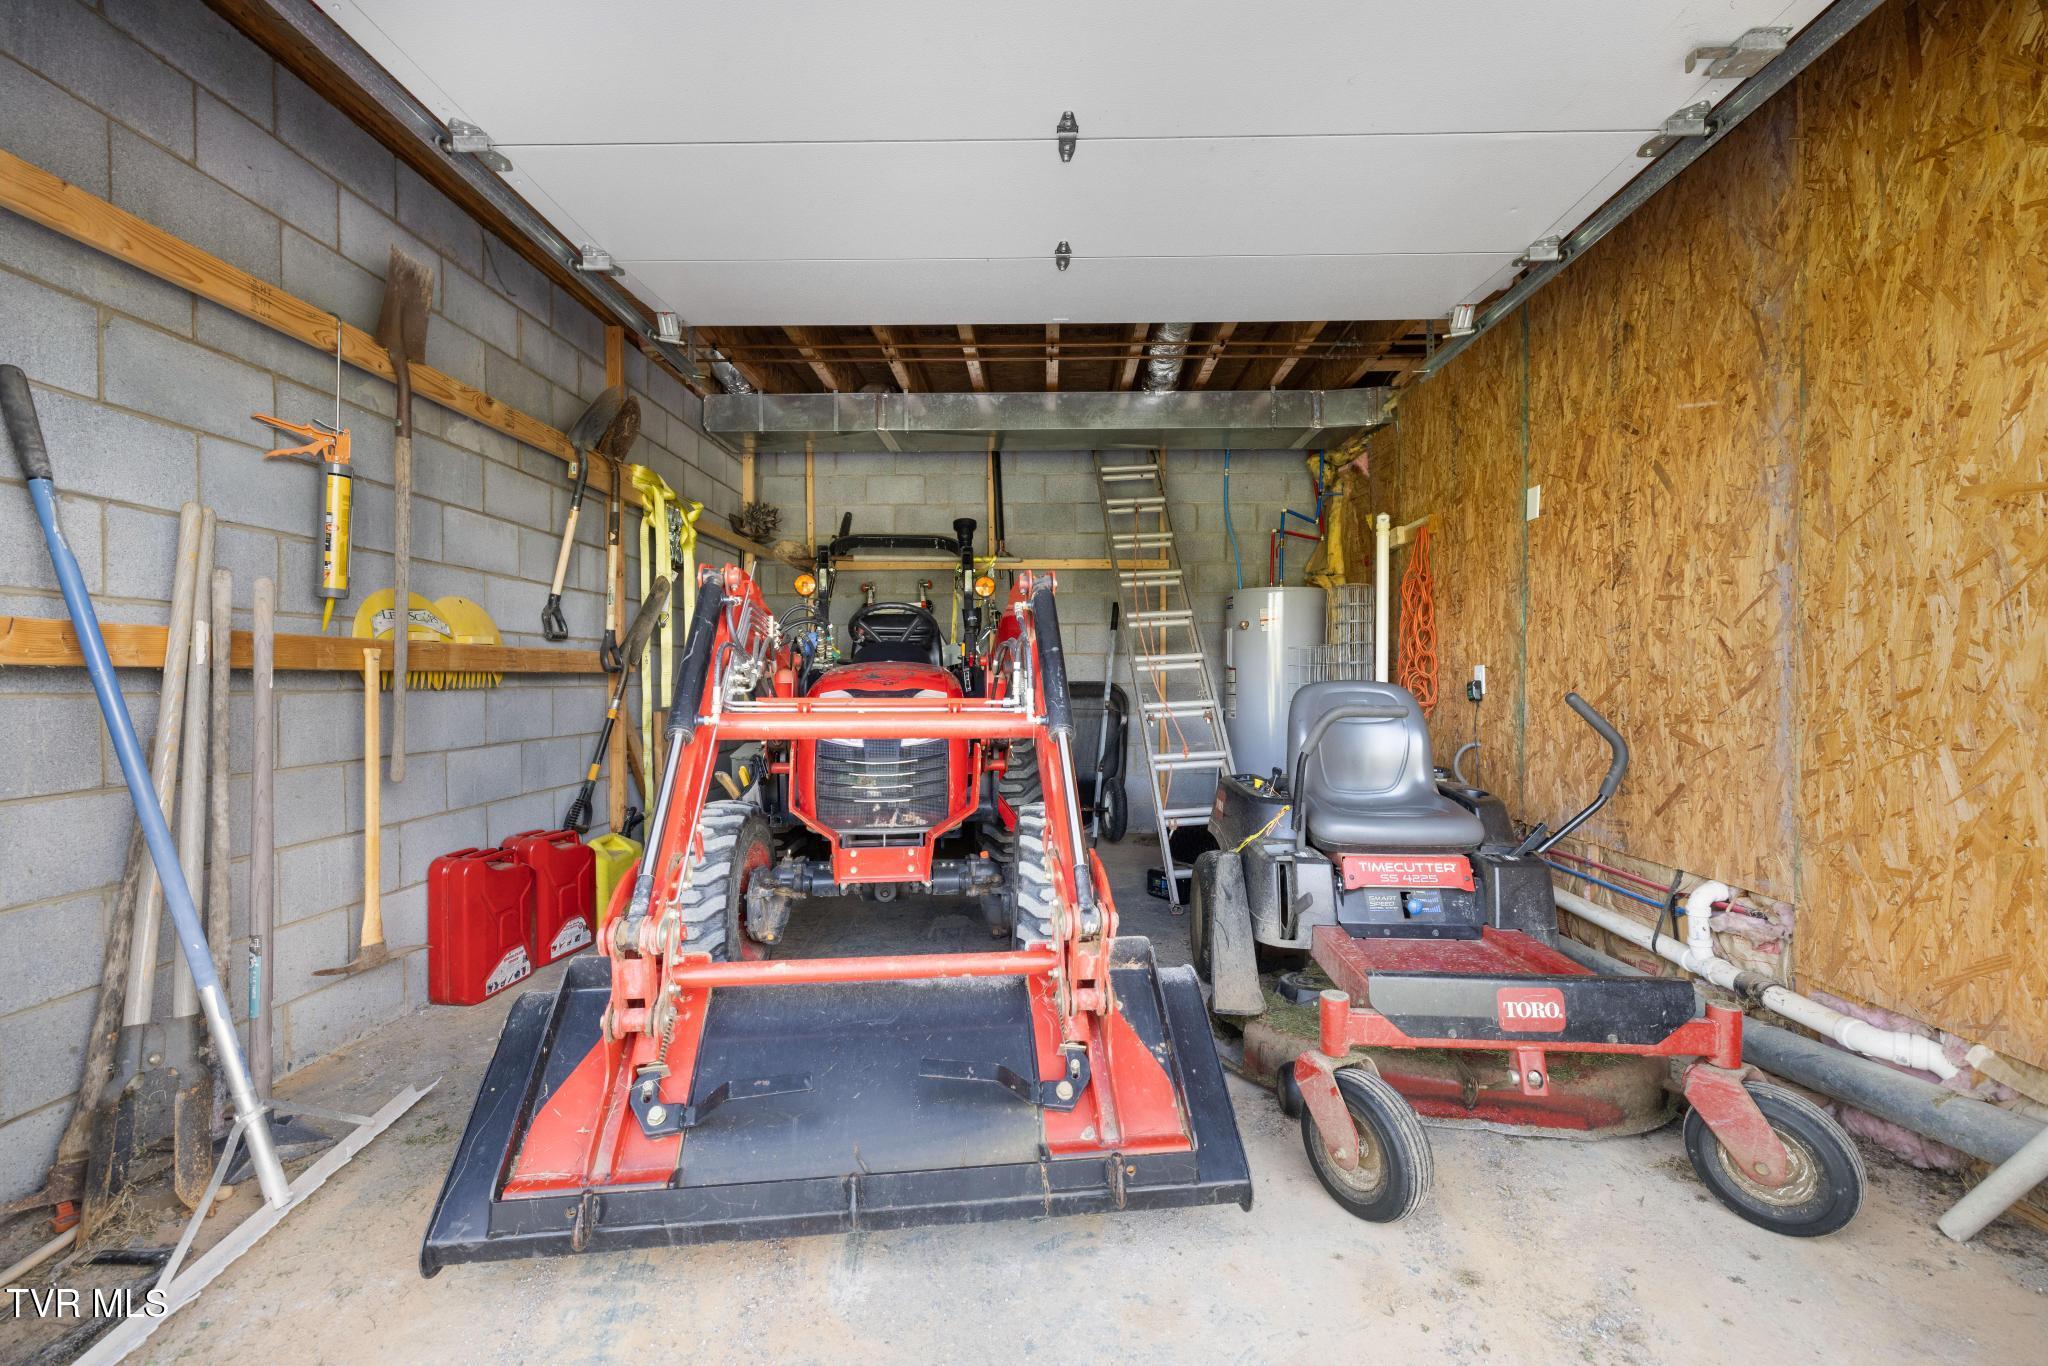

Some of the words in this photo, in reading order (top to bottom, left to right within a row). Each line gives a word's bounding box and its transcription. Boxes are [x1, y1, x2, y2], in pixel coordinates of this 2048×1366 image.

[1358, 861, 1456, 873] TIMECUTTER
[1380, 874, 1398, 883] SS
[1403, 874, 1438, 883] 4225
[1503, 1001, 1561, 1019] TORO
